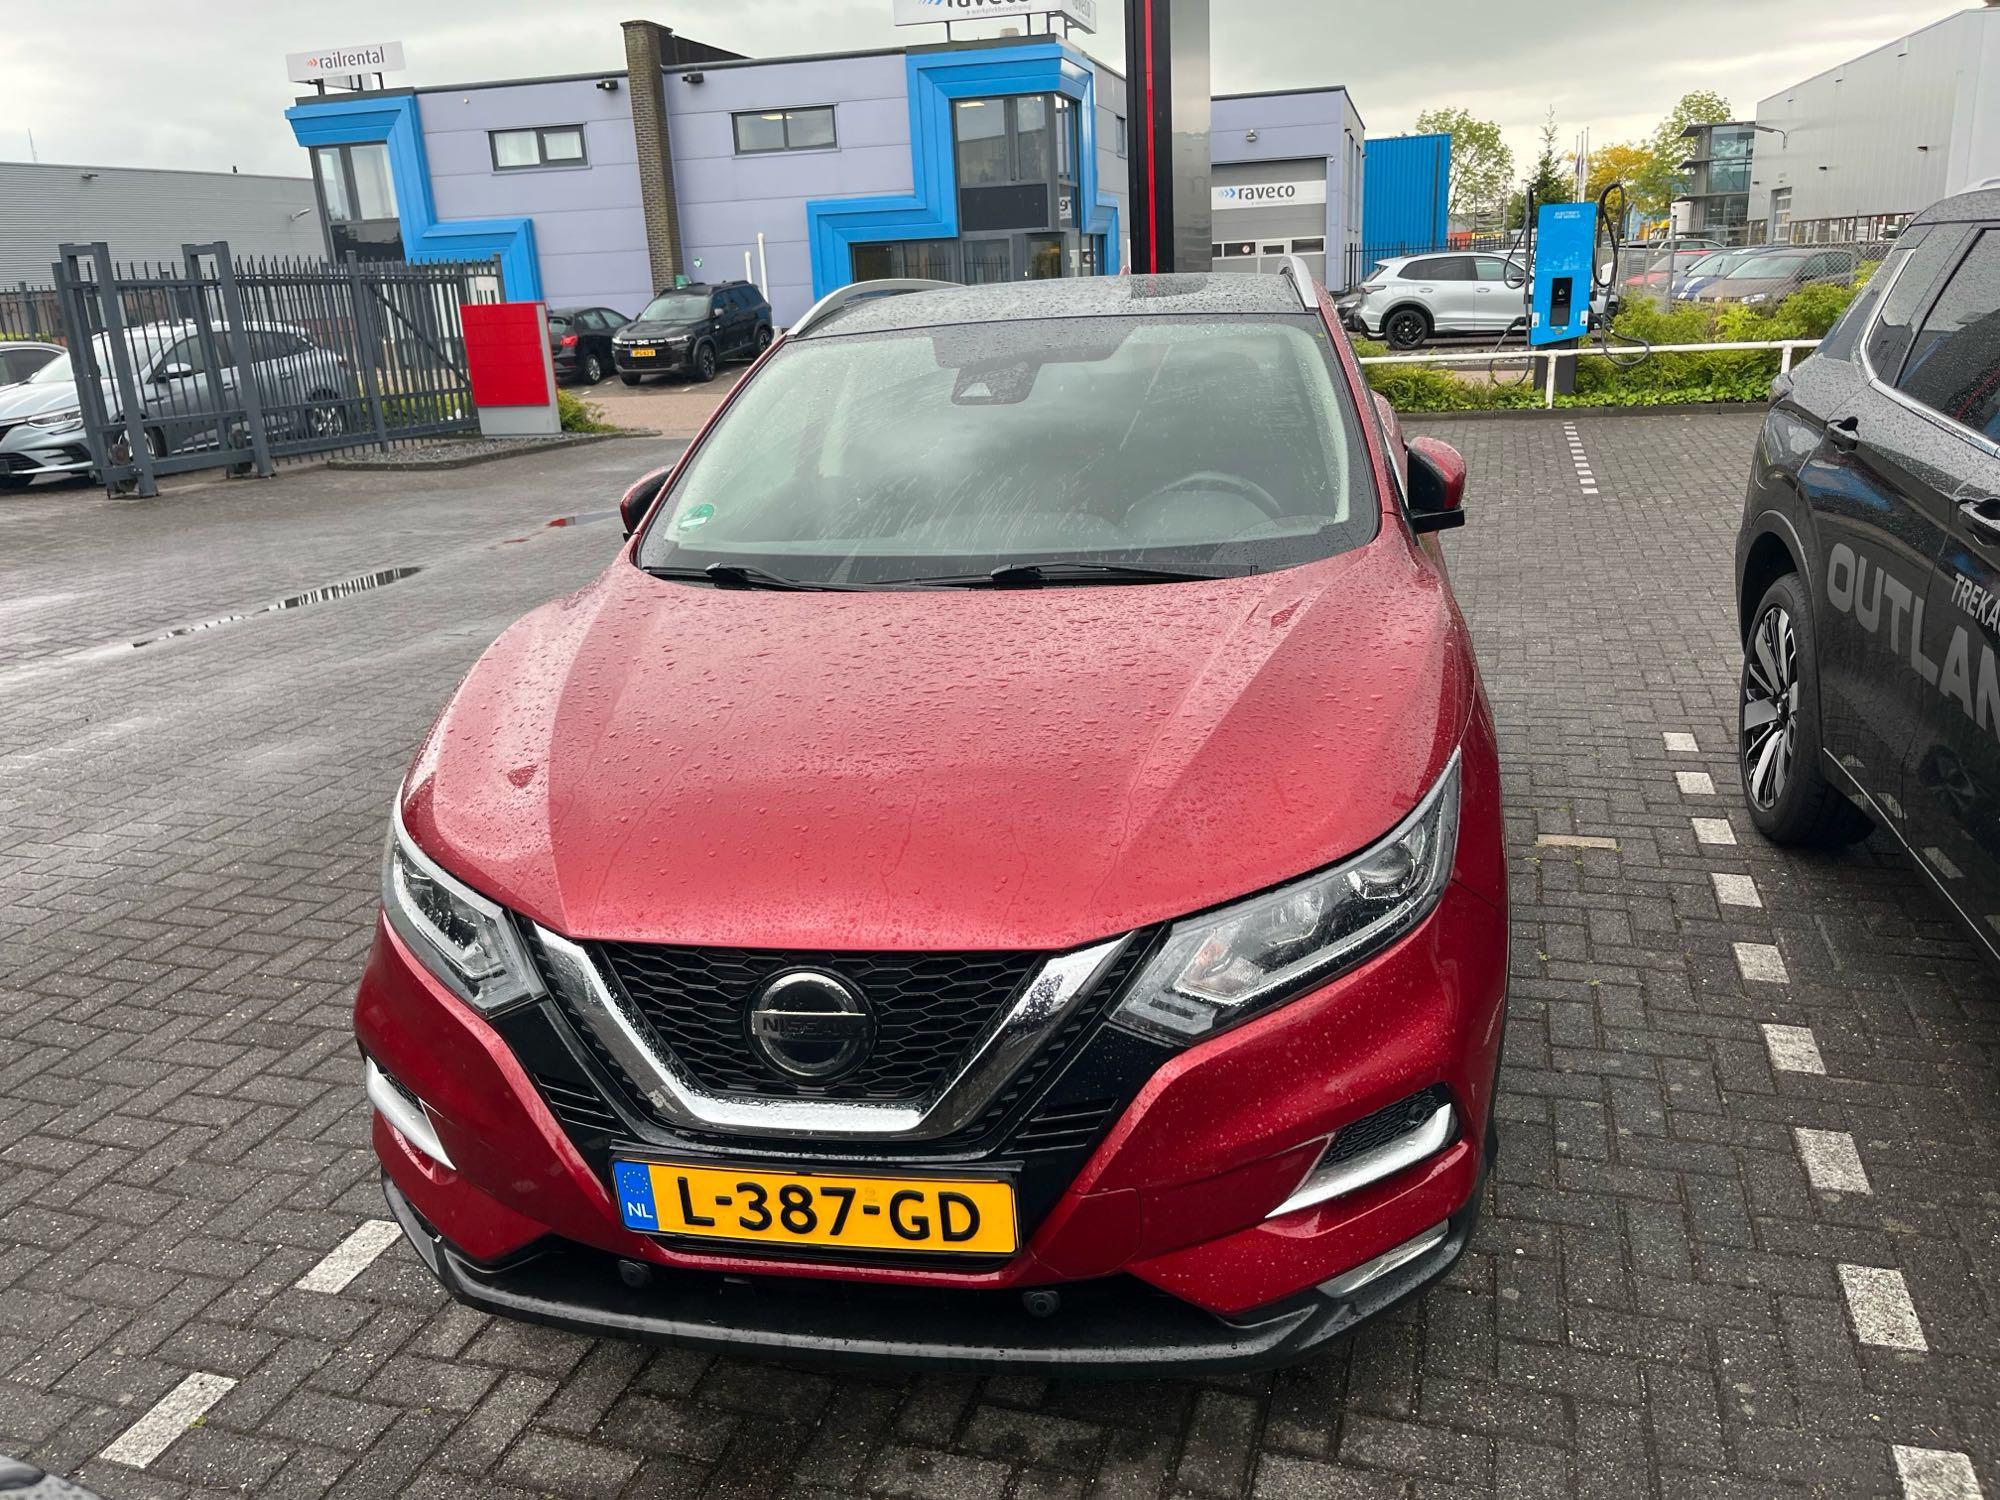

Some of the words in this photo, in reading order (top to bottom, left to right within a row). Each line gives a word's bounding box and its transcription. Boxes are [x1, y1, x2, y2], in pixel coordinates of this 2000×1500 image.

[319, 46, 385, 69] railrental
[1238, 184, 1296, 200] raveco
[1951, 572, 2000, 639] TREKA
[628, 1201, 653, 1219] NL
[677, 1176, 981, 1242] L-387-GD
